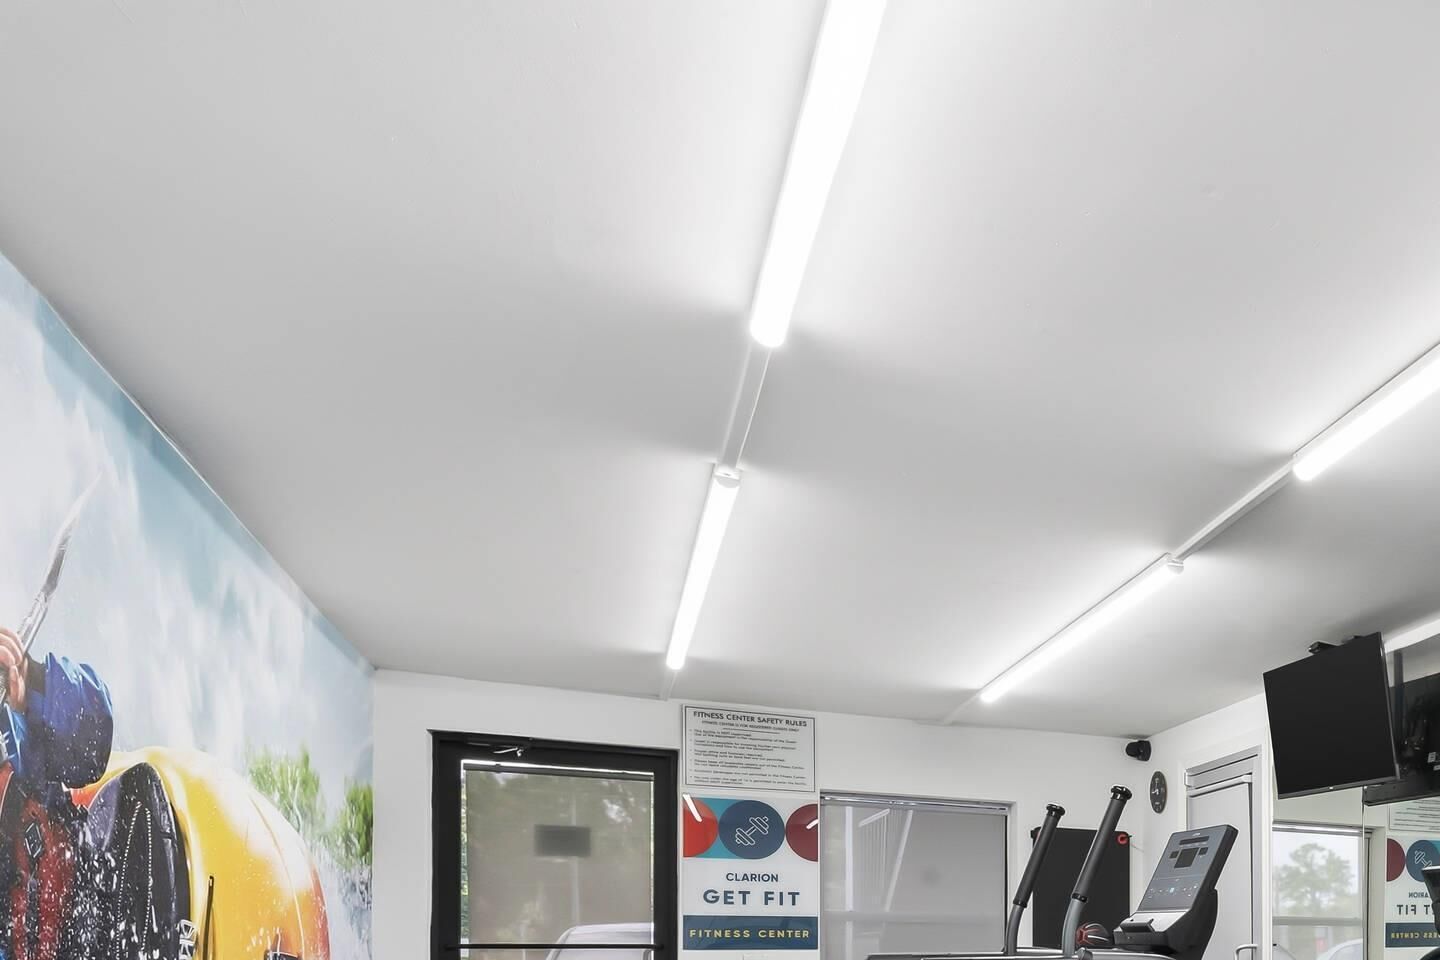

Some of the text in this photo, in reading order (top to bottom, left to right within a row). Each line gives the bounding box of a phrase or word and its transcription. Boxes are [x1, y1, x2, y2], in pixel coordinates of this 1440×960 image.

[693, 711, 807, 727] FITNESS CENTER SAFETY RULES
[726, 872, 779, 882] CLARION
[703, 889, 800, 906] GET FIT
[689, 929, 810, 938] FITNESS CENTER
